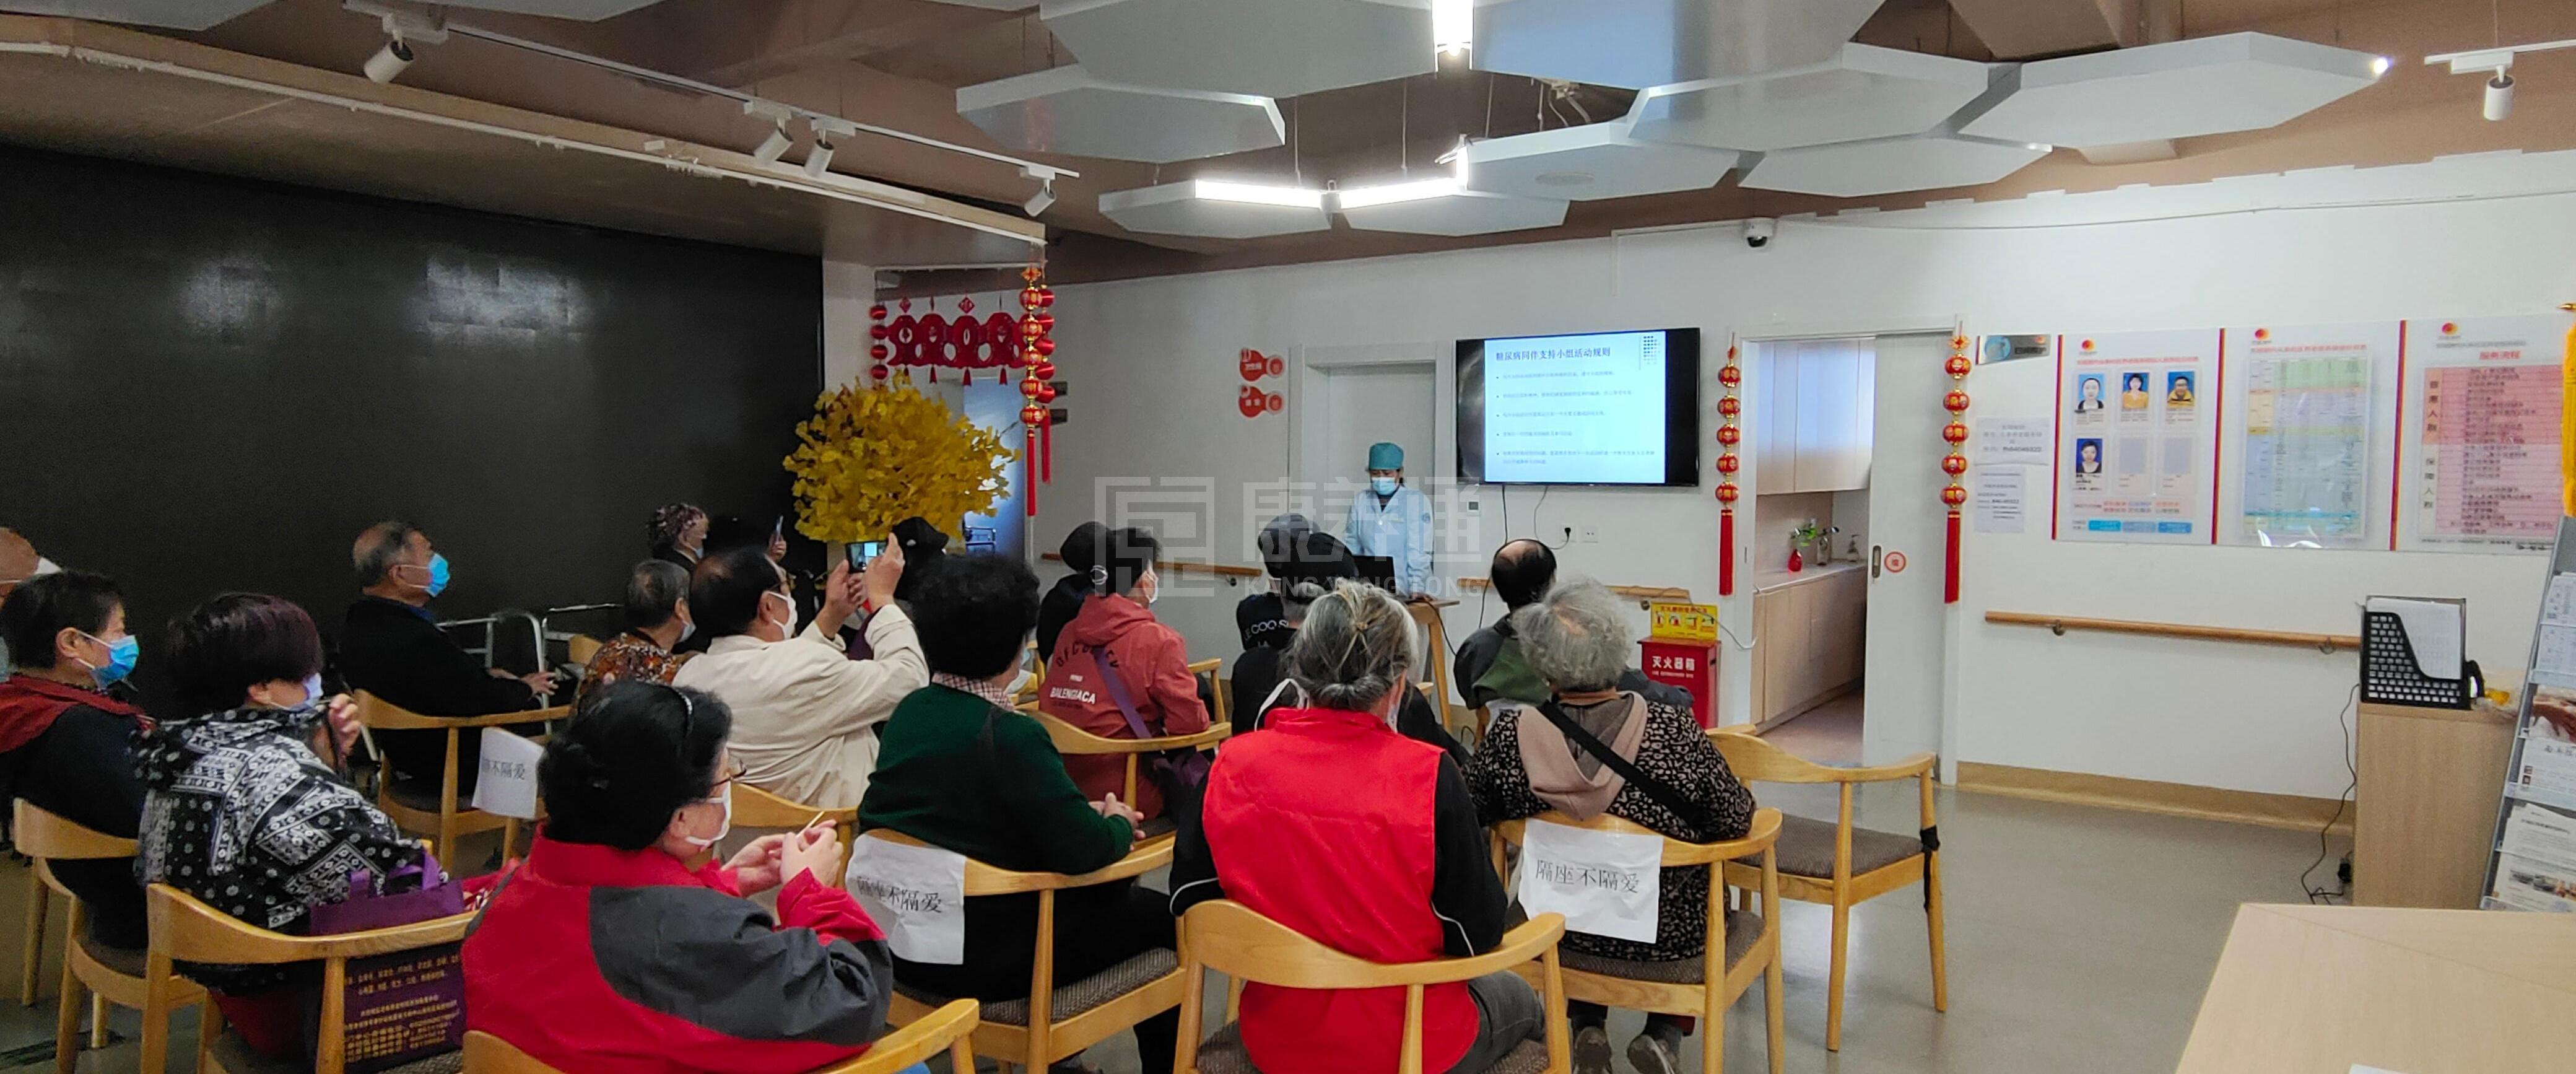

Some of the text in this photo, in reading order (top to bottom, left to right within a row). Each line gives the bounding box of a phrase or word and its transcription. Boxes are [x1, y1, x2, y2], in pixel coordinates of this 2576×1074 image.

[1495, 347, 1611, 362] 糖尿病同伴支持小组活动规则
[1651, 655, 1695, 671] 灭火器箱
[1536, 859, 1640, 893] 隔座不隔爱
